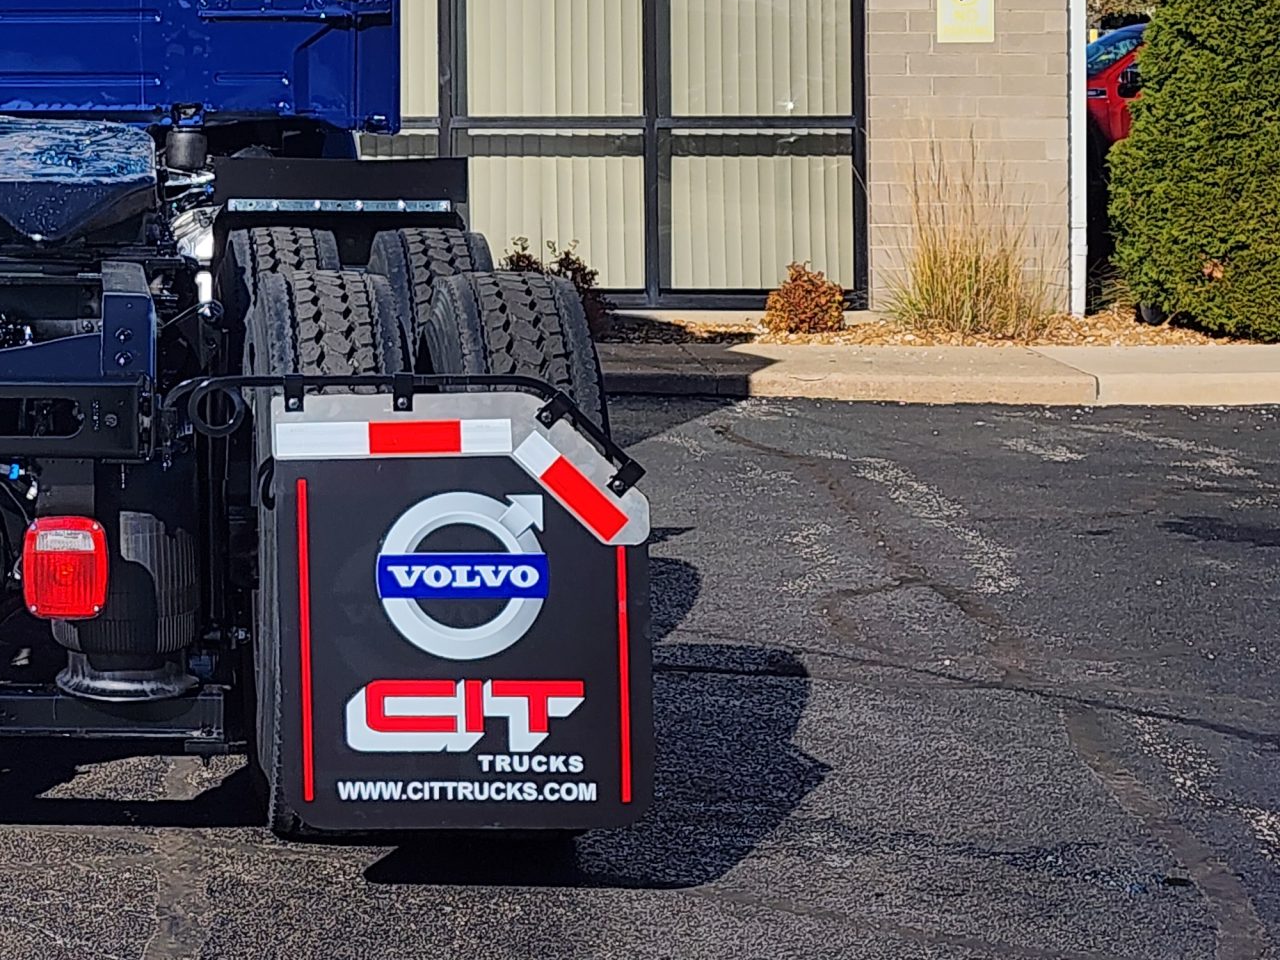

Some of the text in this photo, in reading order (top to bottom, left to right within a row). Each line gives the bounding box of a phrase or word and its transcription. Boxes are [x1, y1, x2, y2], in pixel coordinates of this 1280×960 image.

[387, 565, 540, 588] VOLVO
[348, 679, 585, 751] CIT
[477, 754, 584, 774] TRUCKS
[337, 780, 597, 803] WWW.CITTRUCKS.COM
